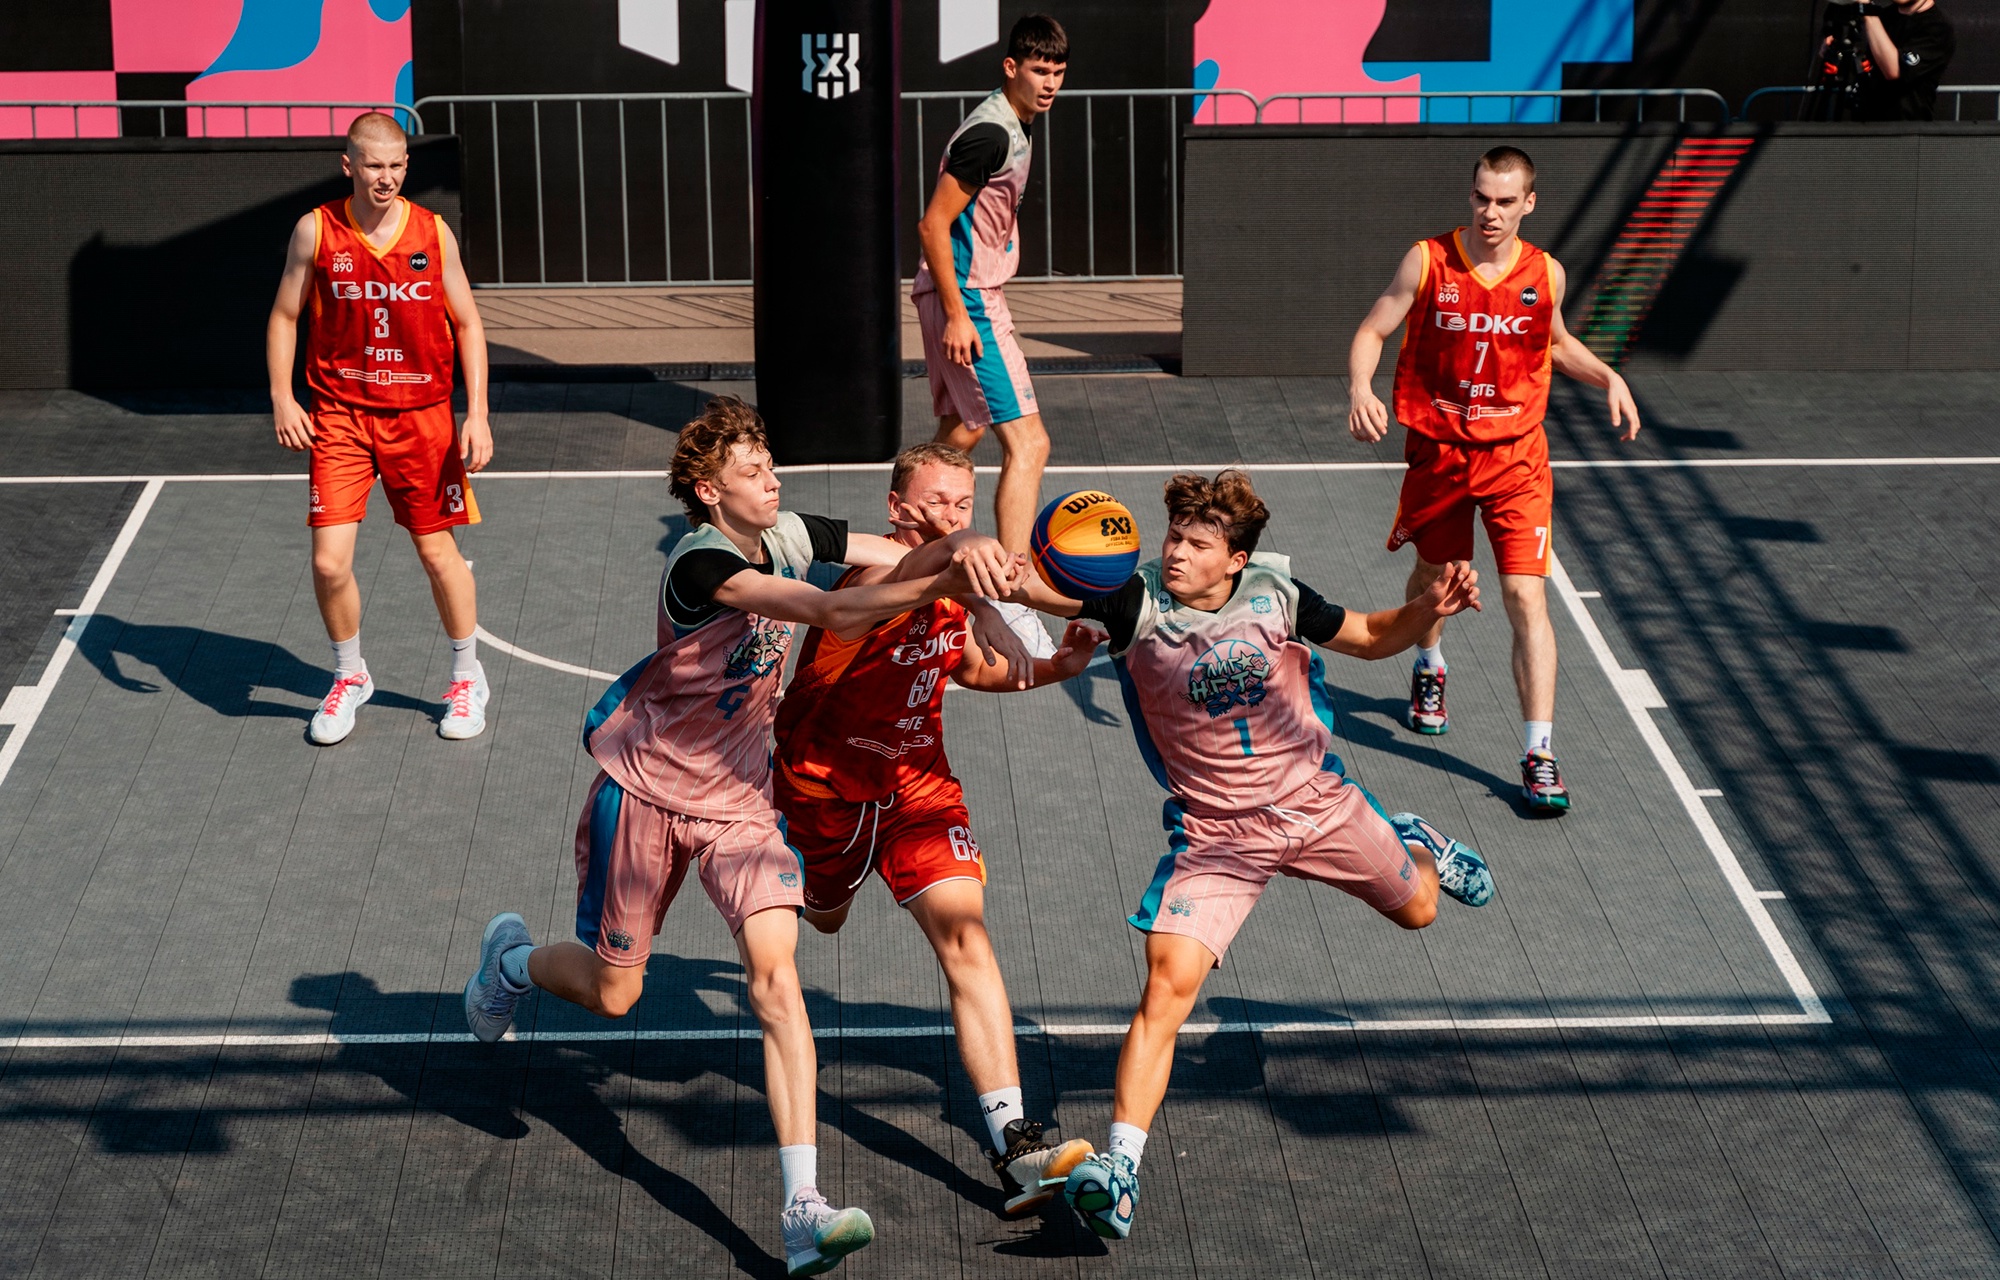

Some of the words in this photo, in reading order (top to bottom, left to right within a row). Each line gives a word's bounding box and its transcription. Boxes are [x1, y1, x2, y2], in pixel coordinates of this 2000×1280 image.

[332, 263, 353, 273] 890
[365, 281, 432, 301] DKC
[1438, 293, 1459, 303] 890
[374, 307, 389, 338] 3
[1468, 312, 1533, 335] DKC
[375, 348, 404, 362] ВТБ
[1474, 341, 1489, 374] 7
[1470, 383, 1496, 398] ВТБ
[446, 484, 465, 513] 3
[1535, 526, 1548, 560] 7
[907, 667, 940, 708] 69
[1233, 718, 1255, 757] 1
[983, 1101, 1009, 1116] ILA
